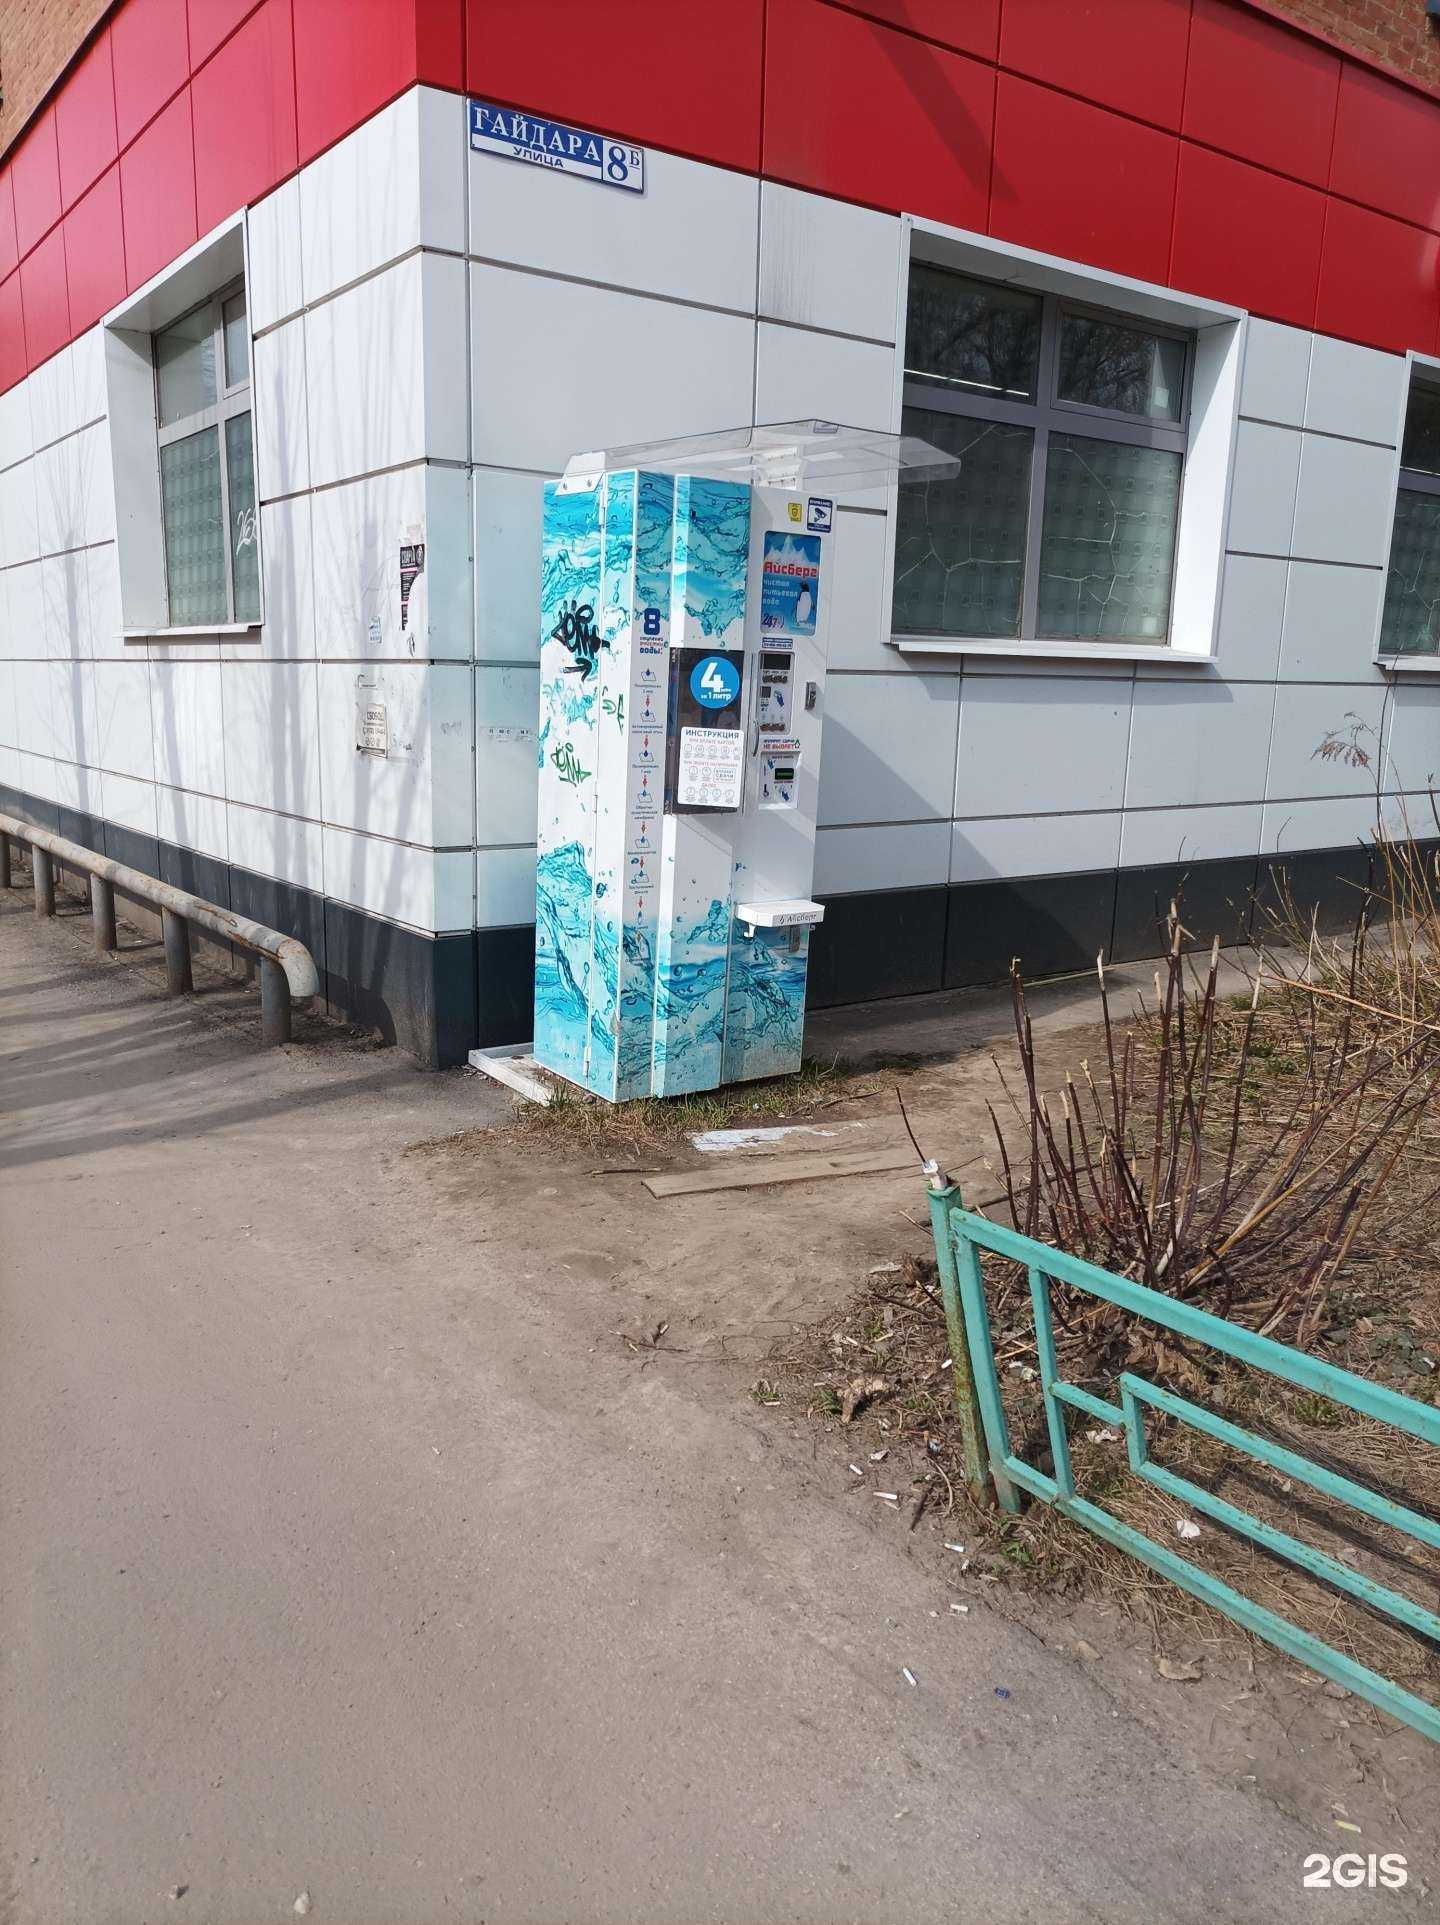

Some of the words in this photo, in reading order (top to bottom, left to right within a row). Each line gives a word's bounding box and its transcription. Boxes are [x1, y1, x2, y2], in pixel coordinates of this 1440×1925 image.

[474, 106, 601, 162] ГАЙДАРА
[607, 145, 628, 181] 8
[513, 145, 564, 168] УЛИЦА
[763, 561, 818, 578] Айсберг
[643, 607, 661, 636] 8
[700, 662, 724, 693] 4
[712, 693, 732, 701] литр
[685, 729, 739, 739] ИНСТРУКЦИЯ
